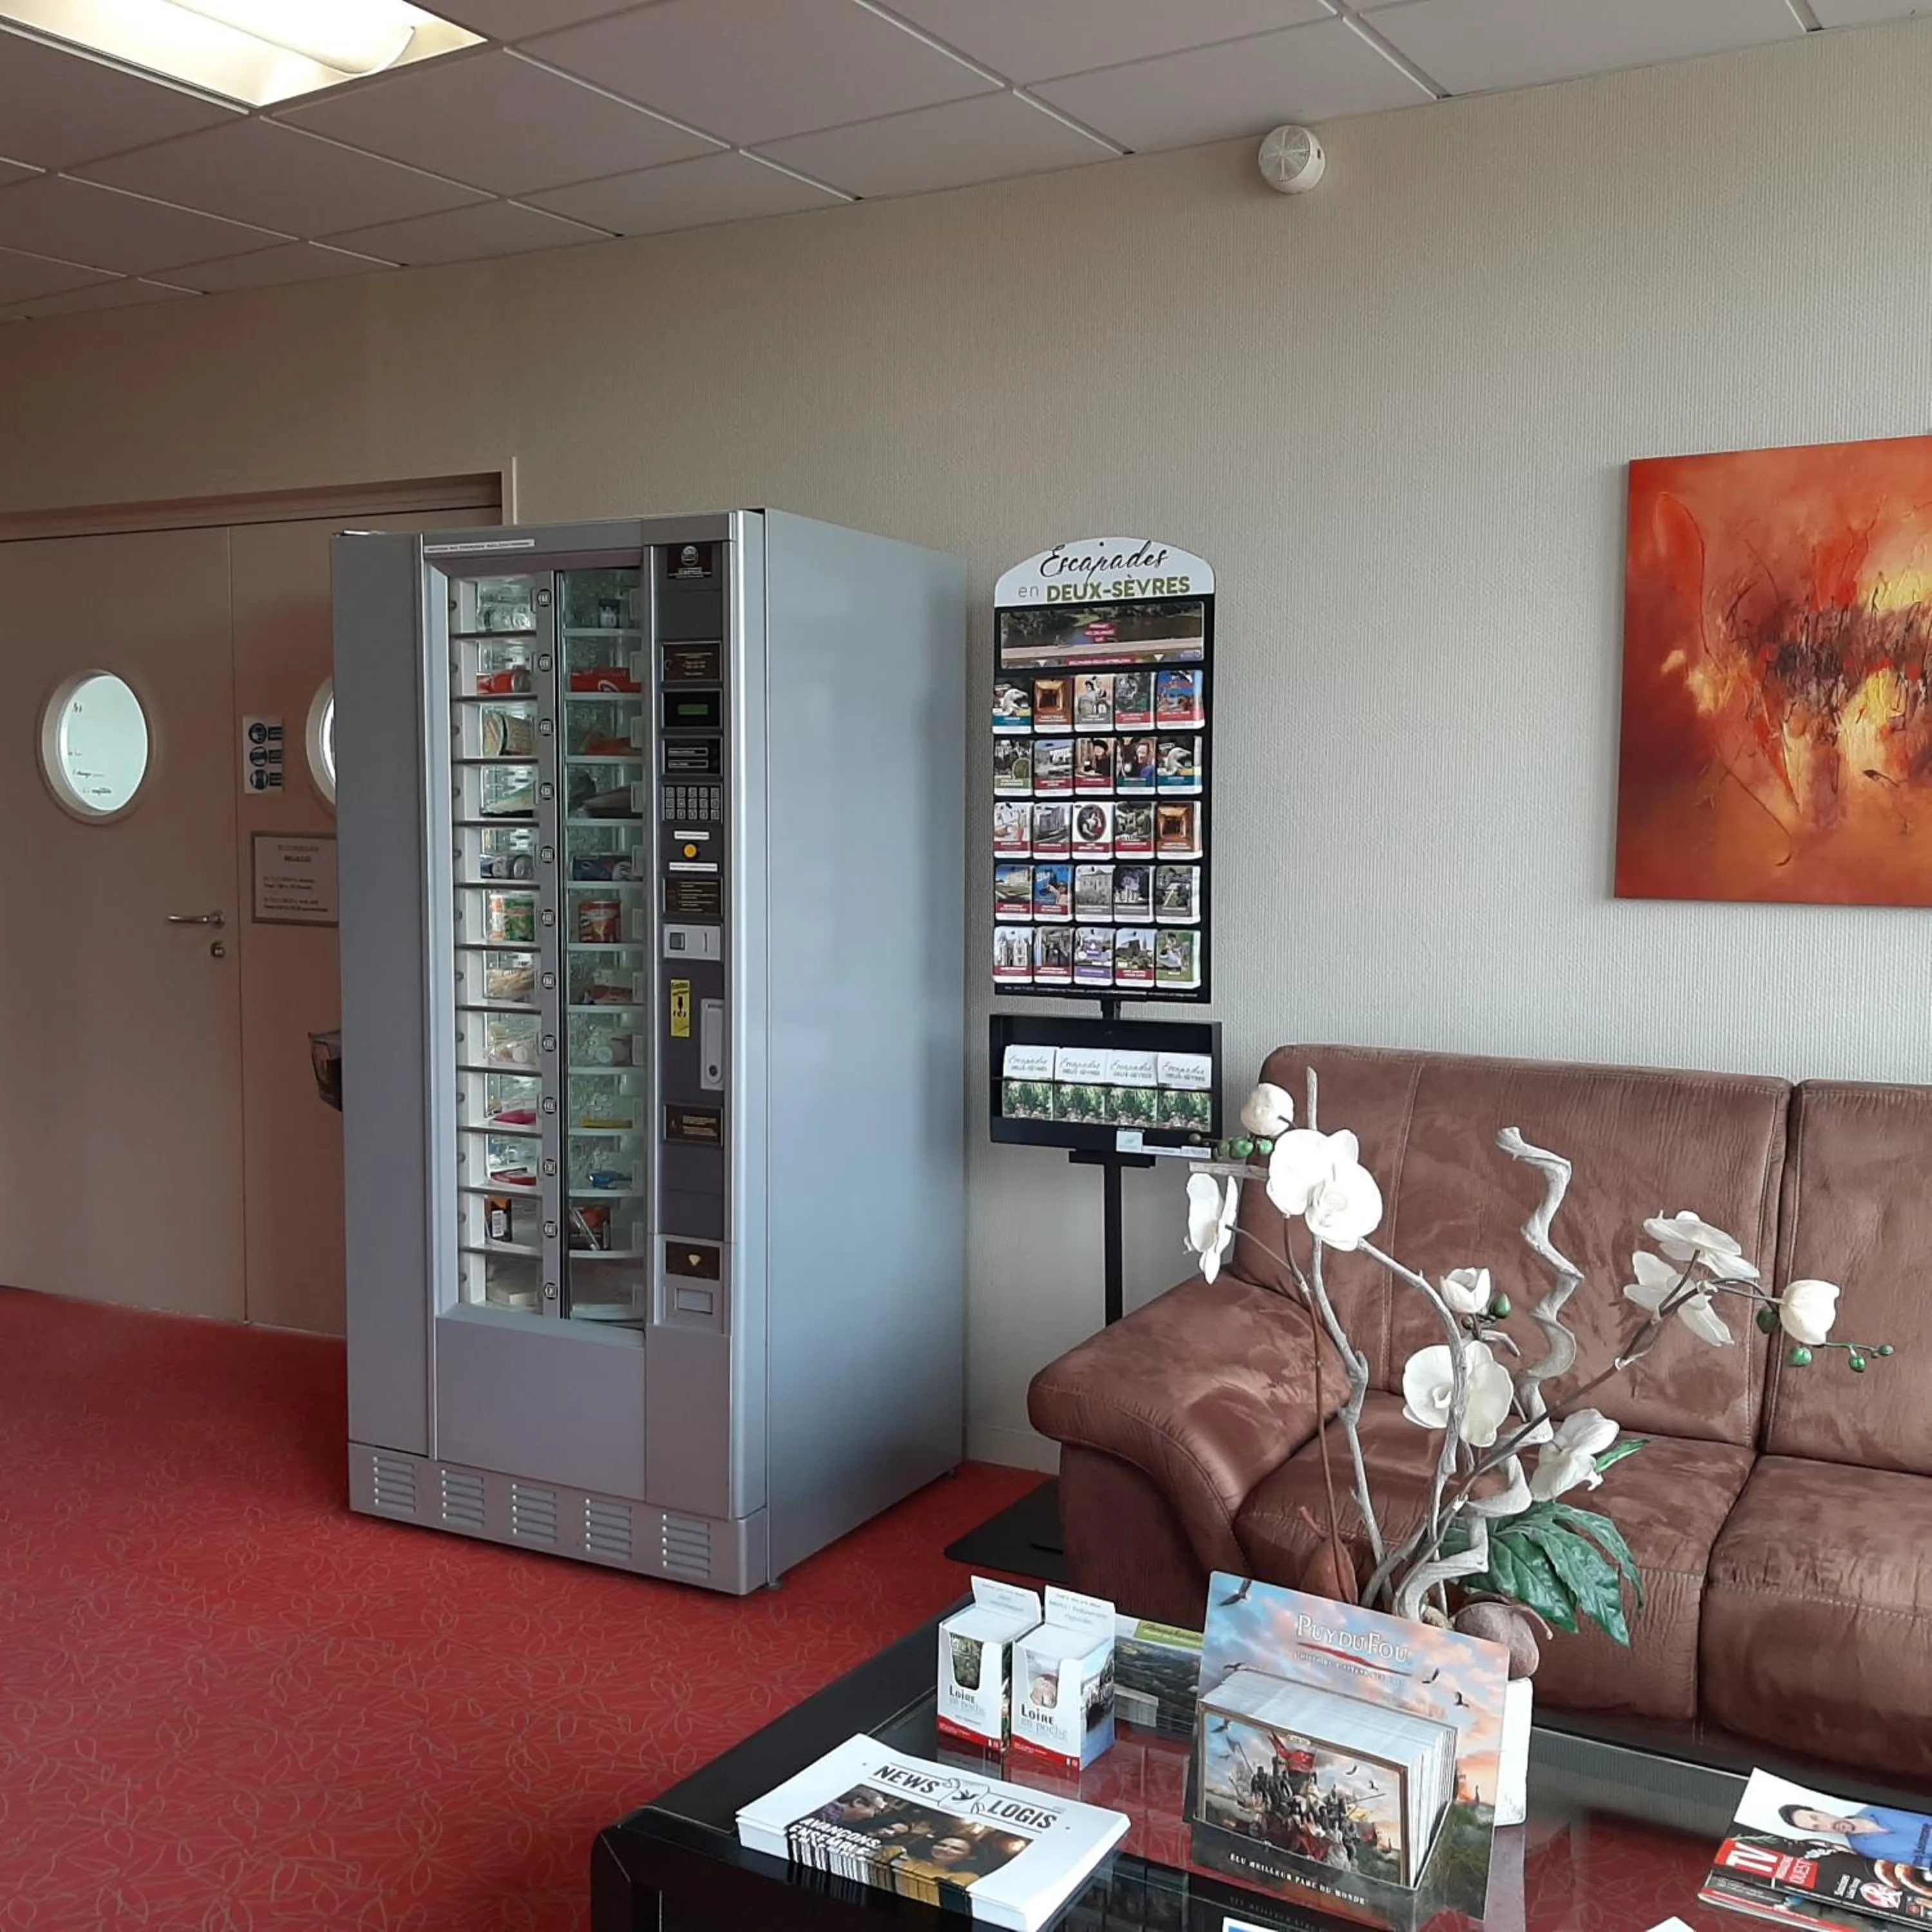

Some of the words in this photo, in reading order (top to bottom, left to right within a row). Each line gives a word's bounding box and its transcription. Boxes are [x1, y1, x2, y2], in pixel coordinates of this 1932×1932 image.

[1039, 540, 1170, 586] Escapades
[1018, 585, 1039, 598] en
[1046, 575, 1191, 602] DEUX-SÈVRES
[1021, 1703, 1055, 1725] Loire
[873, 1764, 941, 1795] NEWS
[987, 1799, 1059, 1830] LOGIS
[1726, 1841, 1778, 1873] TV
[1294, 1875, 1318, 1889] PARC
[1320, 1883, 1332, 1894] DU
